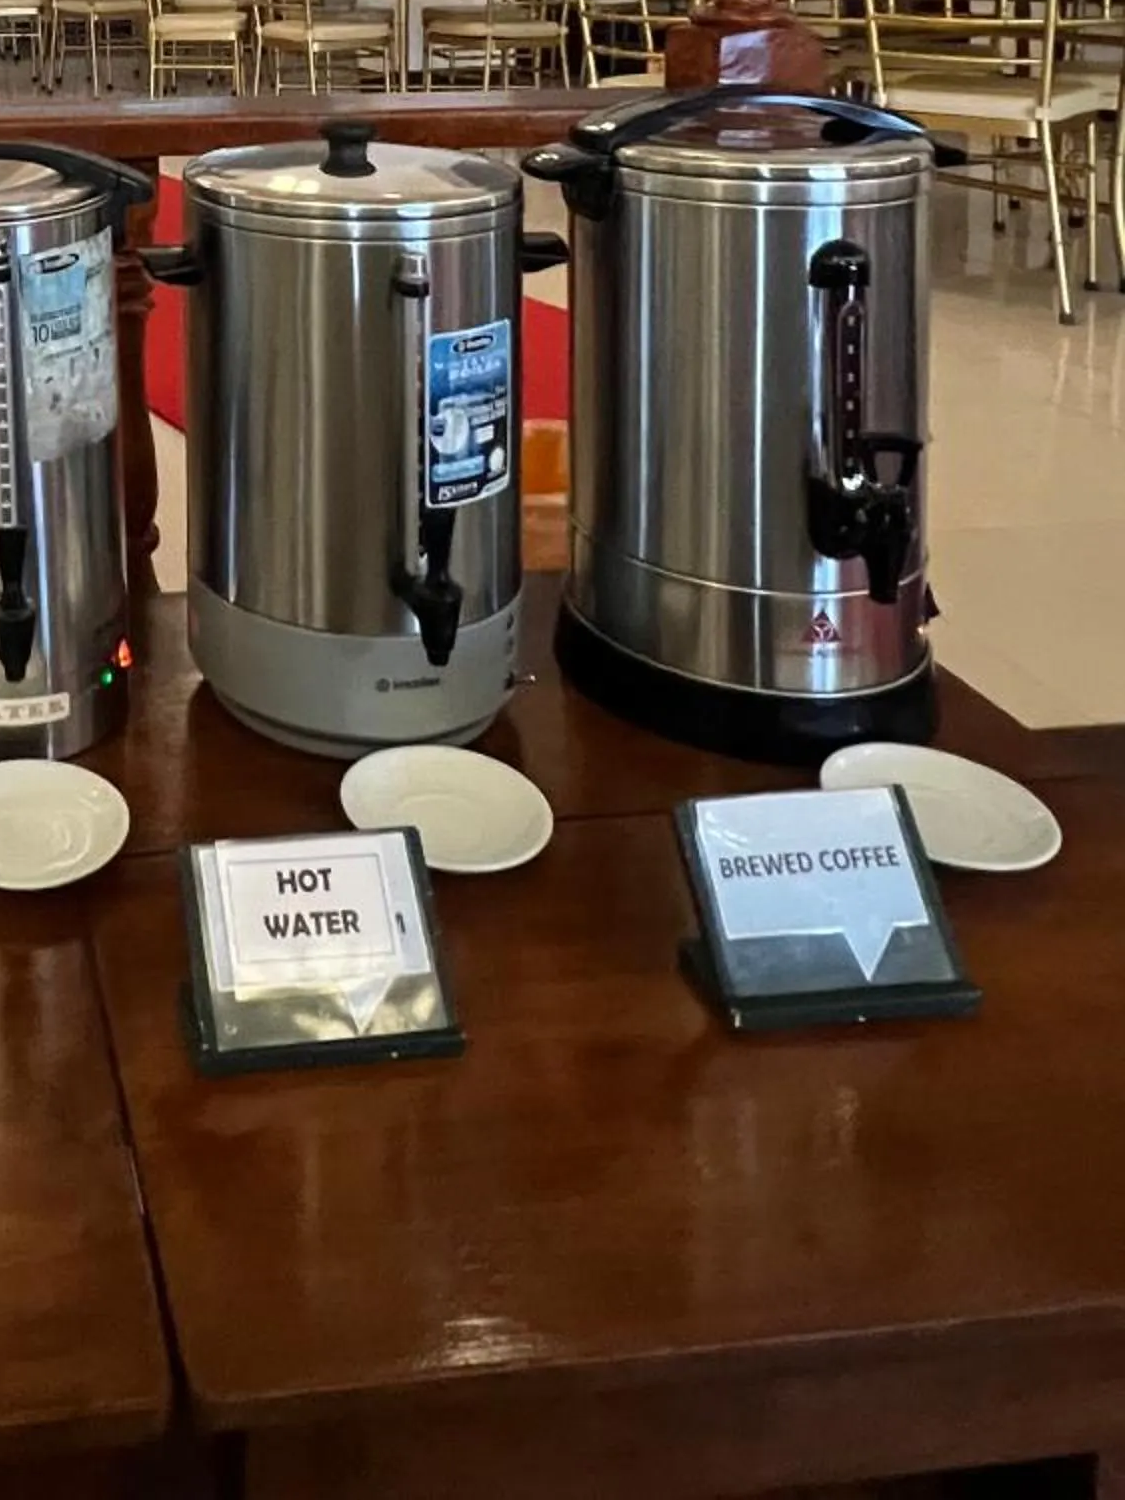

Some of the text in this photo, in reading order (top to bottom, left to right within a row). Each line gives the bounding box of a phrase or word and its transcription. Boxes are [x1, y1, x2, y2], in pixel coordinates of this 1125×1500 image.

[718, 845, 901, 879] BREWED COFFEE
[277, 869, 332, 893] HOT
[263, 909, 360, 939] WATER
